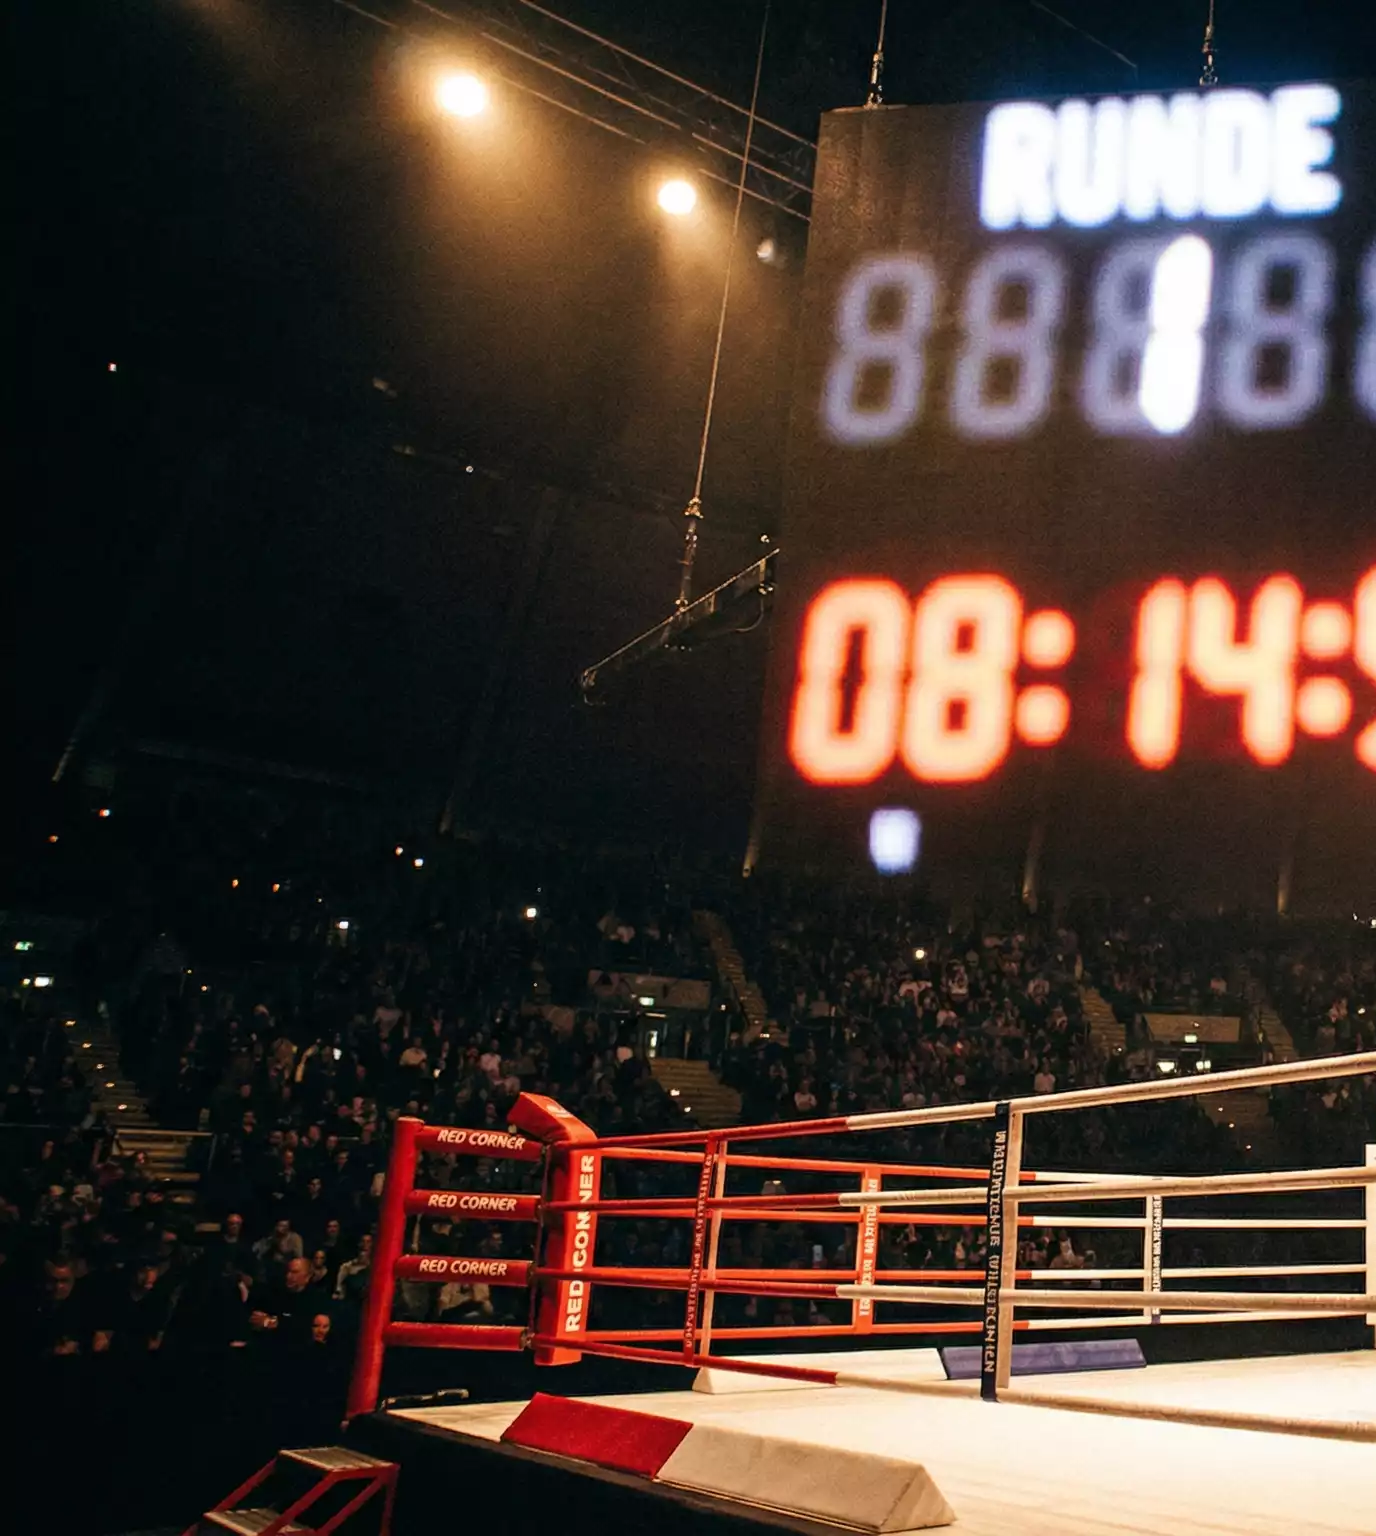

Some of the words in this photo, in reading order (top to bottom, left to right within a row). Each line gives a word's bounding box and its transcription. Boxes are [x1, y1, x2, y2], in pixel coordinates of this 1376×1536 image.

[979, 81, 1343, 231] RUNDE
[437, 1129, 466, 1143] RED
[468, 1131, 526, 1149] CORNER
[427, 1194, 457, 1208] RED
[459, 1196, 518, 1211] CORNER
[419, 1259, 448, 1273] RED
[450, 1260, 508, 1276] CORNER
[565, 1280, 584, 1332] RED
